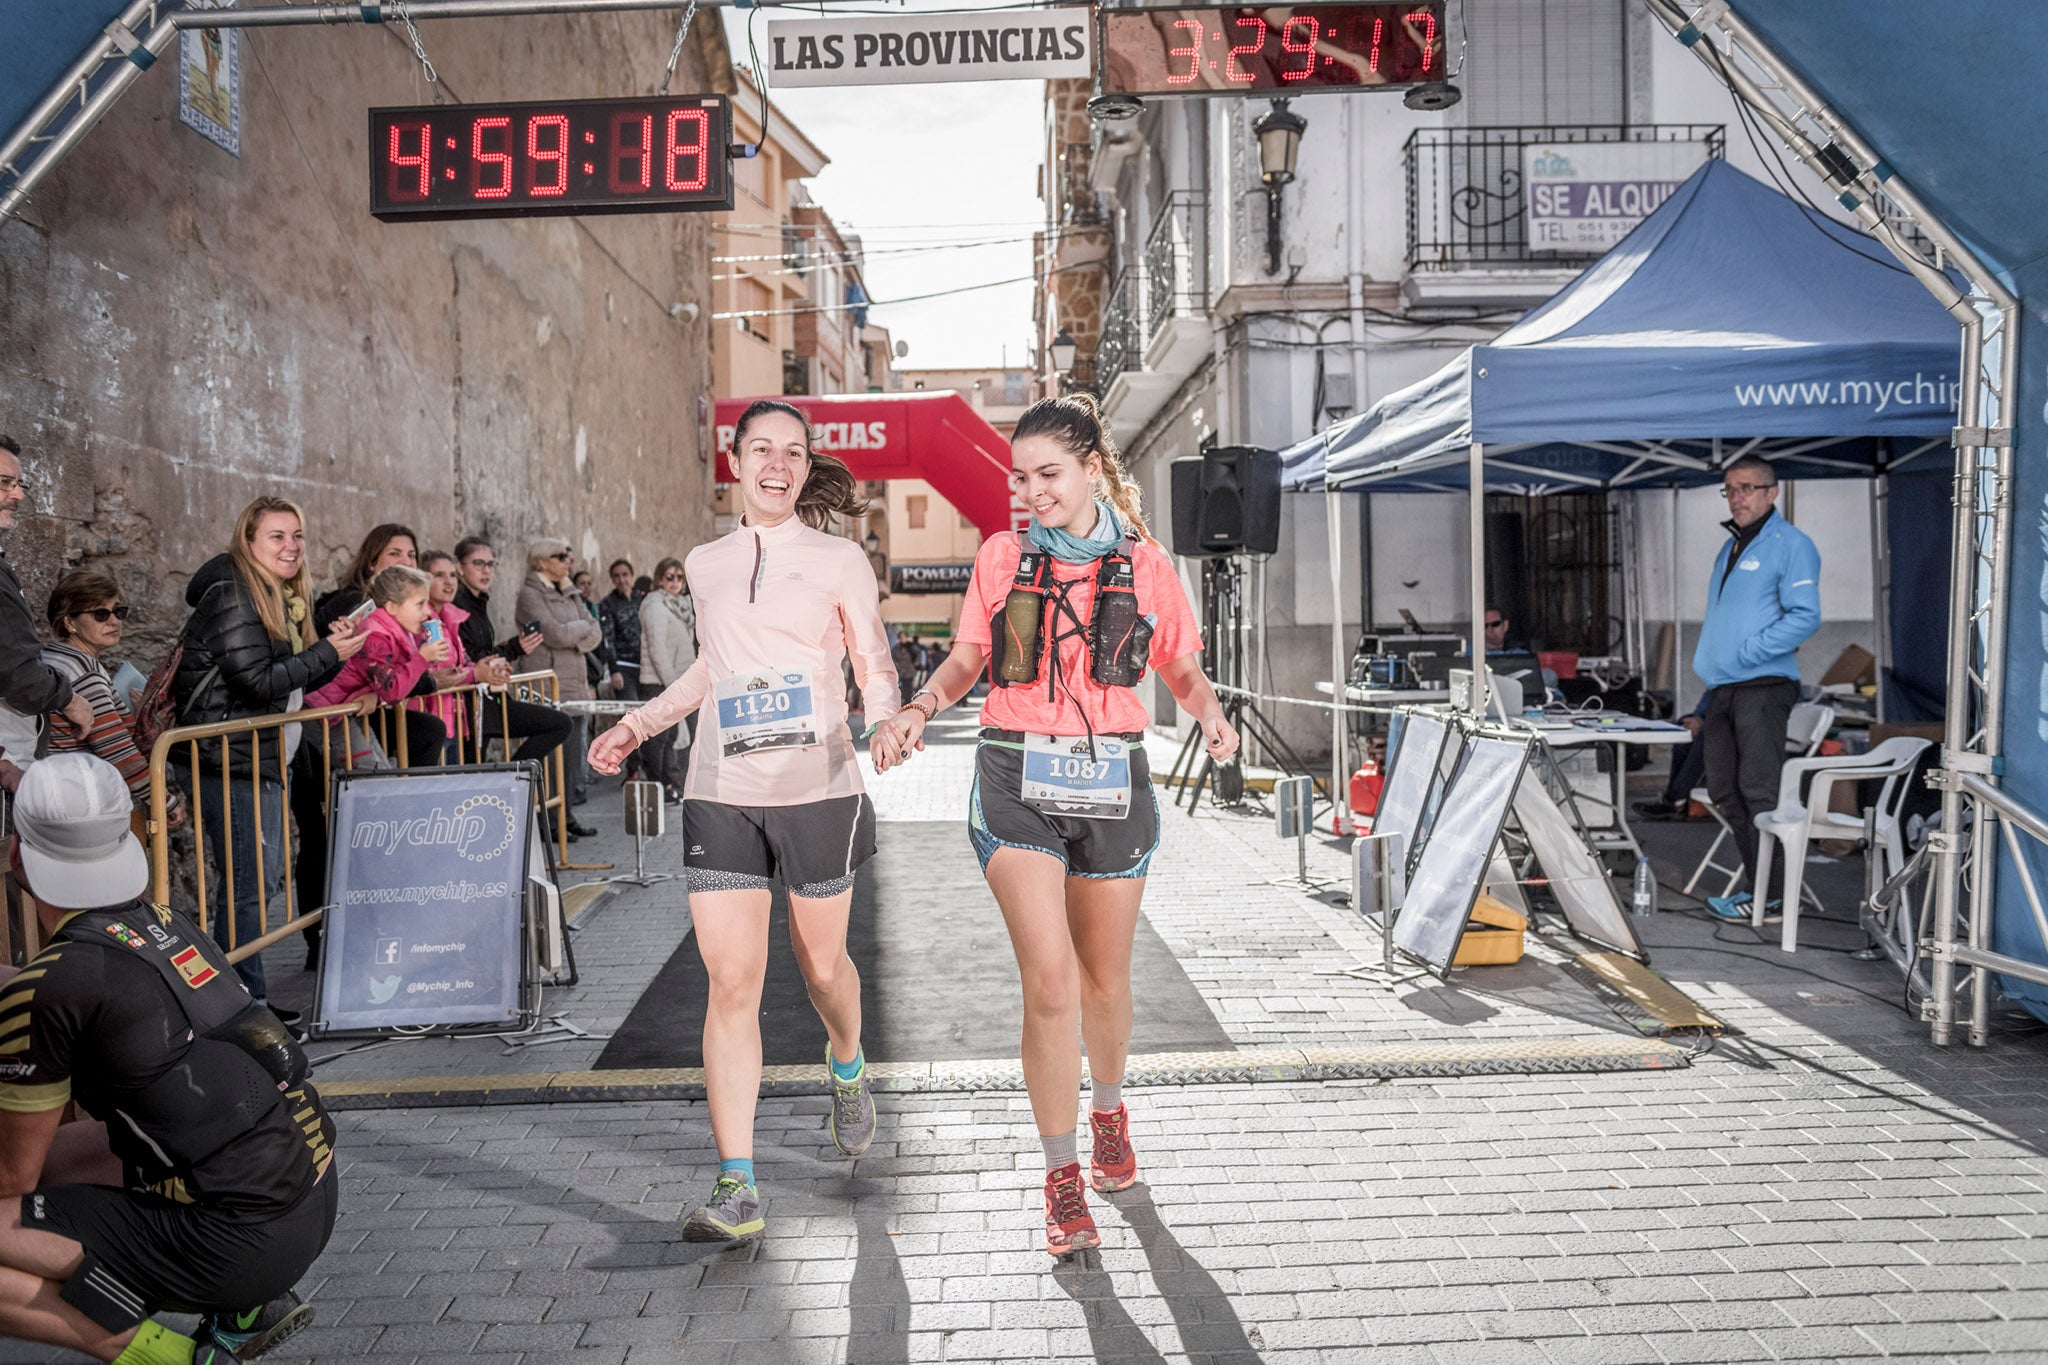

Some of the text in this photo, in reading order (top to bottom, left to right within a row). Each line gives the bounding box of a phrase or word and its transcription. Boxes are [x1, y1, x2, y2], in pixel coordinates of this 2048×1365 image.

[773, 26, 1086, 71] LAS PROVINCIAS
[1166, 12, 1436, 85] 3:29:17
[388, 109, 709, 198] 4:59:18
[1535, 185, 1571, 216] SE
[902, 567, 974, 581] POWERA
[733, 692, 790, 719] 1120
[1049, 757, 1110, 780] 1087
[351, 807, 486, 856] mychip
[346, 880, 508, 906] www.mychip.es
[406, 980, 475, 993] @Mychip_Info
